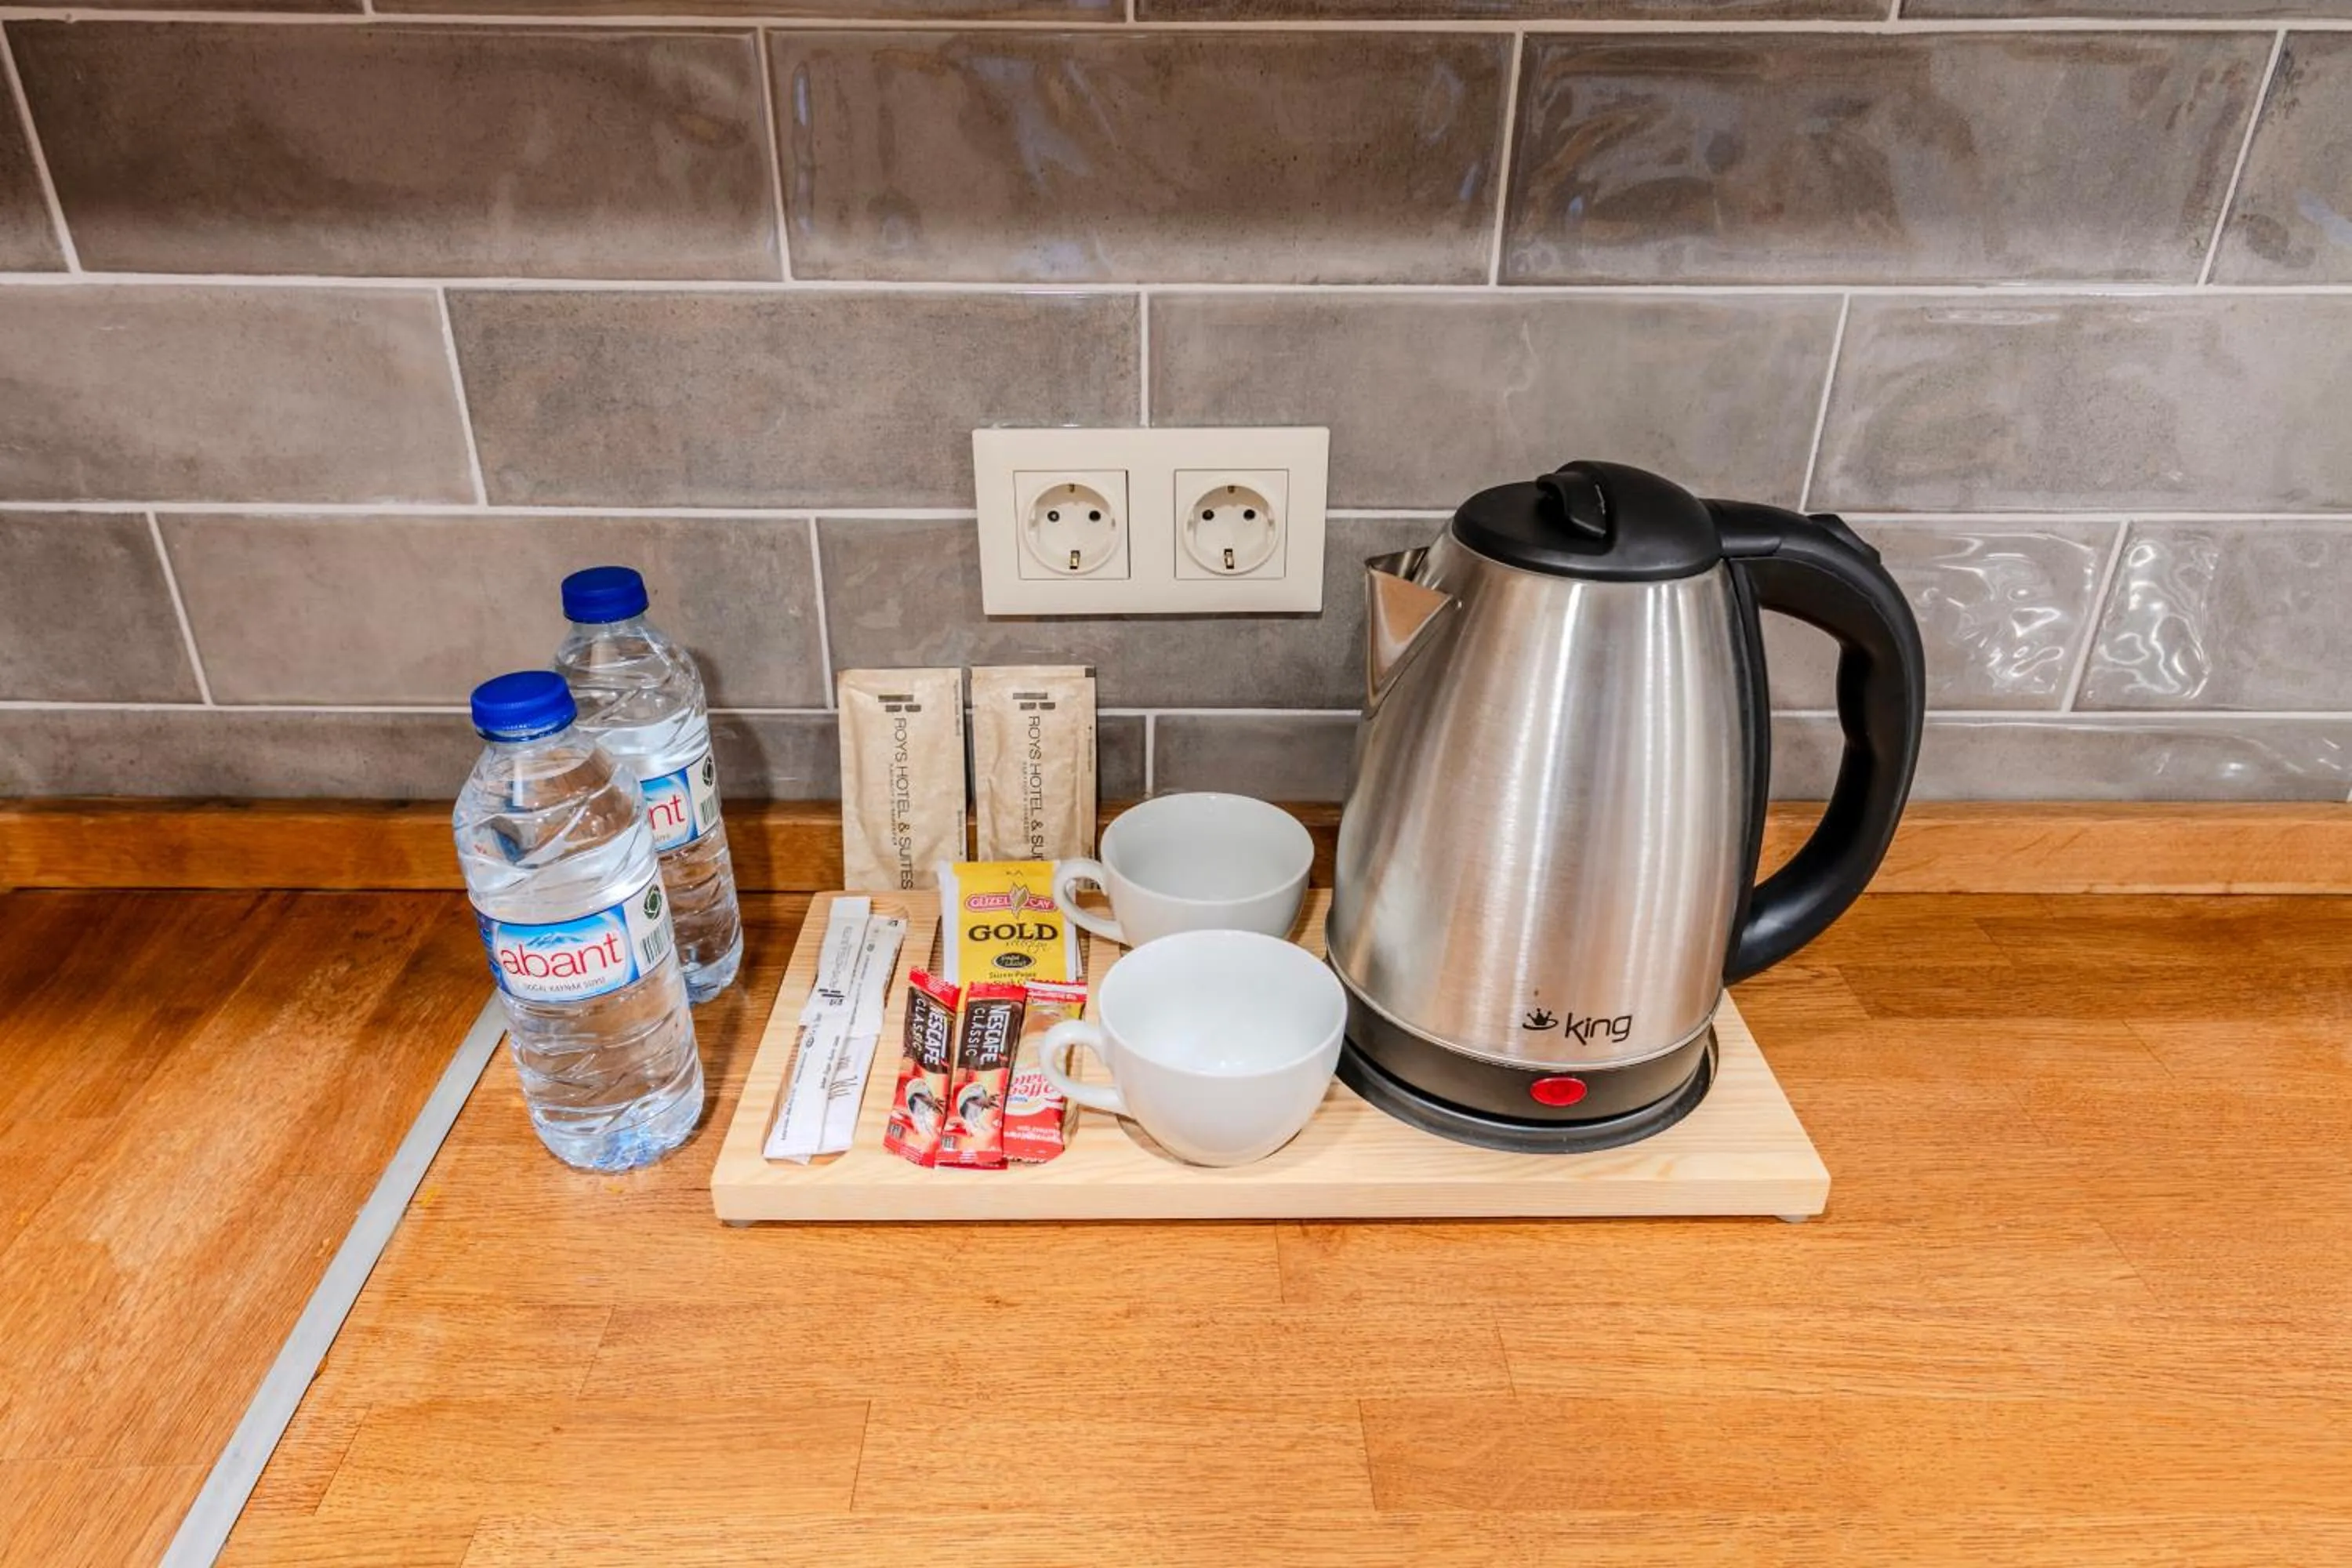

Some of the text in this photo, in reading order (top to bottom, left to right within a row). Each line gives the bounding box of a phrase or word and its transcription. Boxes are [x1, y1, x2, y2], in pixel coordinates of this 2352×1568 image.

[894, 717, 908, 762] ROYS
[897, 766, 910, 818] HOTEL
[1029, 716, 1044, 860] ROYS HOTEL & SUI
[898, 822, 910, 833] &
[898, 836, 914, 890] SUITES
[500, 932, 622, 978] abant
[968, 923, 1058, 942] GOLD
[912, 997, 927, 1052] CLASSIC
[965, 1007, 985, 1057] CLASSIC
[1564, 1012, 1632, 1046] king
